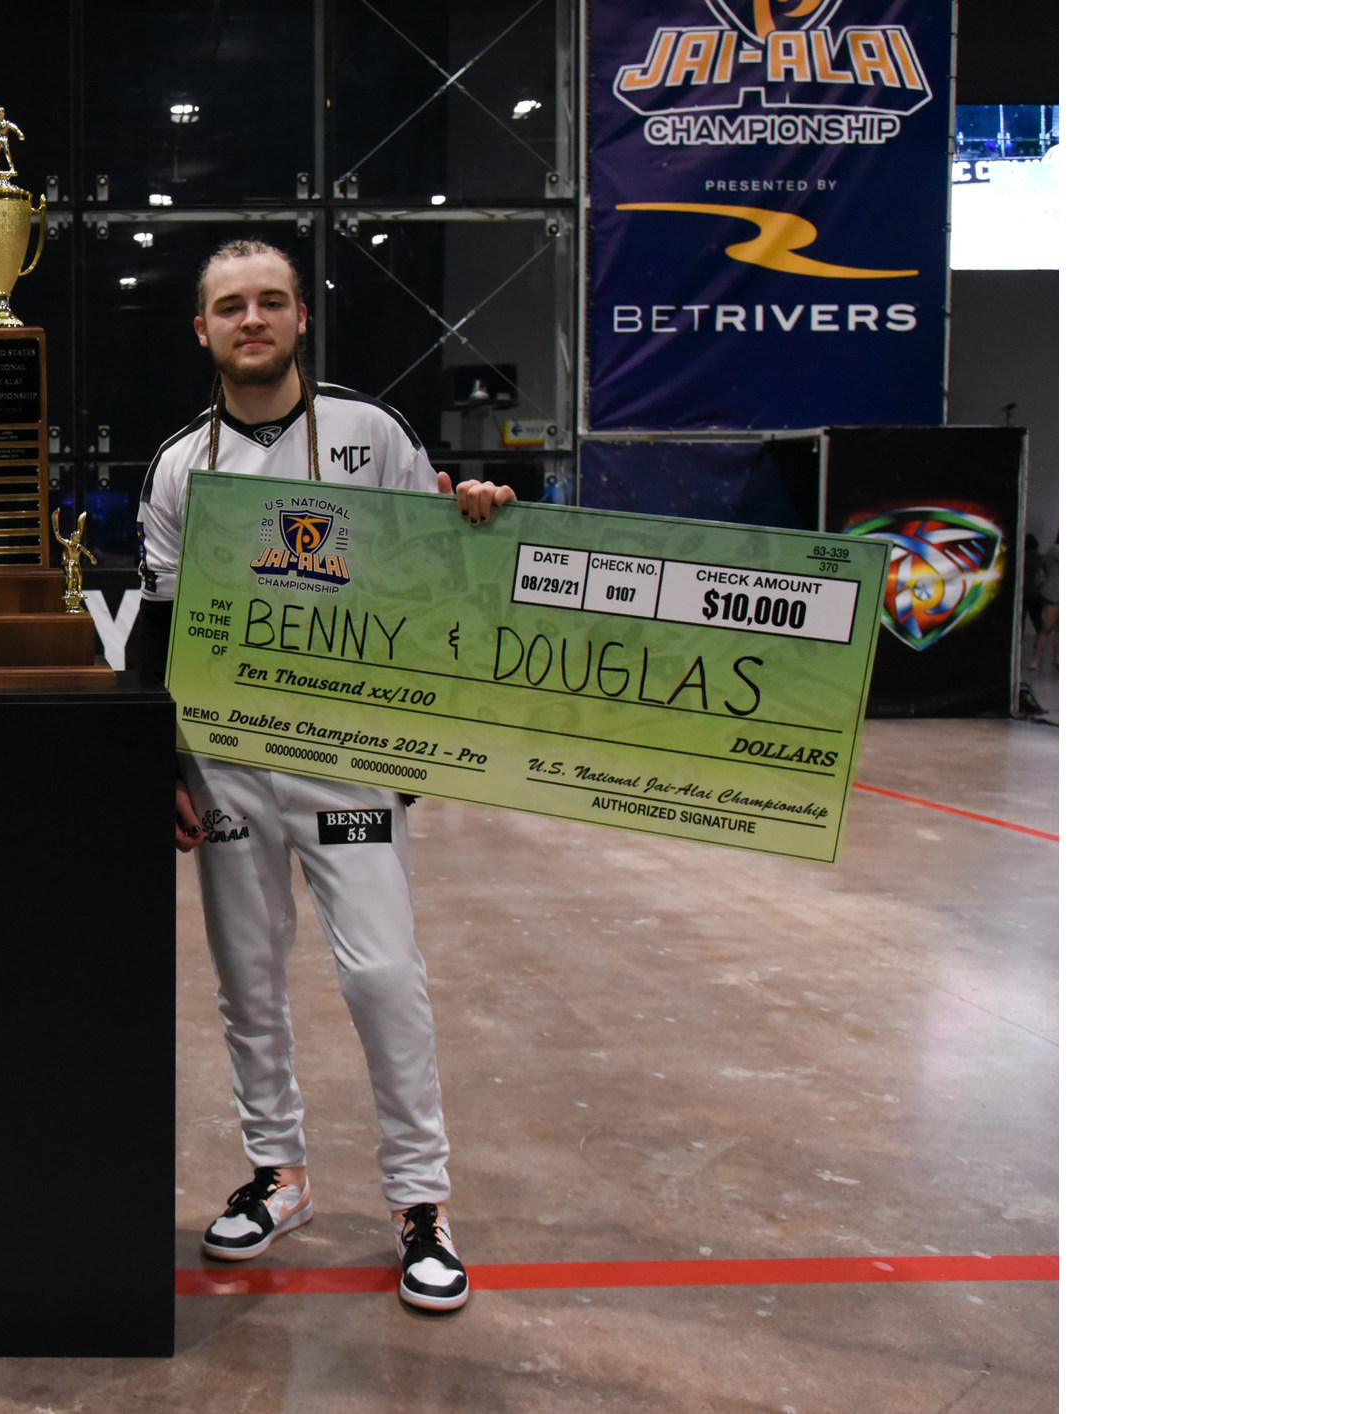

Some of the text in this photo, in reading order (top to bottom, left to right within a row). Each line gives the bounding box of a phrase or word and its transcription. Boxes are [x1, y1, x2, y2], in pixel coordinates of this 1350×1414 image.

[616, 27, 927, 94] JAI-ALAI
[644, 115, 901, 145] CHAMPIONSHIP
[705, 179, 837, 192] PRESENTED BY
[613, 304, 917, 334] BETRIVERS
[331, 446, 370, 474] MCC
[264, 497, 350, 520] U.S. NATIONAL
[261, 517, 348, 536] 20 21
[533, 550, 569, 565] DATE
[813, 545, 849, 559] 63-339
[251, 548, 350, 581] JAI-ALAI
[591, 557, 658, 576] CHECK NO.
[818, 562, 838, 573] 370
[258, 577, 340, 595] CHAMPIONSHIP
[521, 575, 580, 596] 08/29/21
[606, 584, 636, 602] 0107
[695, 569, 823, 595] CHECK AMOUNT
[211, 599, 233, 611] PAY
[702, 588, 807, 629] $10,000
[189, 611, 231, 626] TO THE
[188, 626, 229, 641] ORDER
[212, 644, 228, 656] OF
[244, 598, 407, 661] BENNY
[493, 626, 764, 716] DOUGLAS
[237, 663, 436, 706] Ten Thousand xx/100
[182, 705, 219, 722] MEMO
[227, 709, 291, 732] Doubles
[295, 721, 389, 749] Champions
[392, 737, 439, 757] 2021
[456, 747, 488, 765] Pro
[265, 742, 338, 764] 000000000000
[350, 757, 427, 780] 000000000000
[729, 737, 839, 767] DOLLARS
[528, 758, 829, 819] U.S. National Jai-Alai Championship
[326, 811, 385, 826] BENNY
[592, 796, 756, 834] AUTHORIZED SIGNATURE
[346, 827, 367, 841] 55
